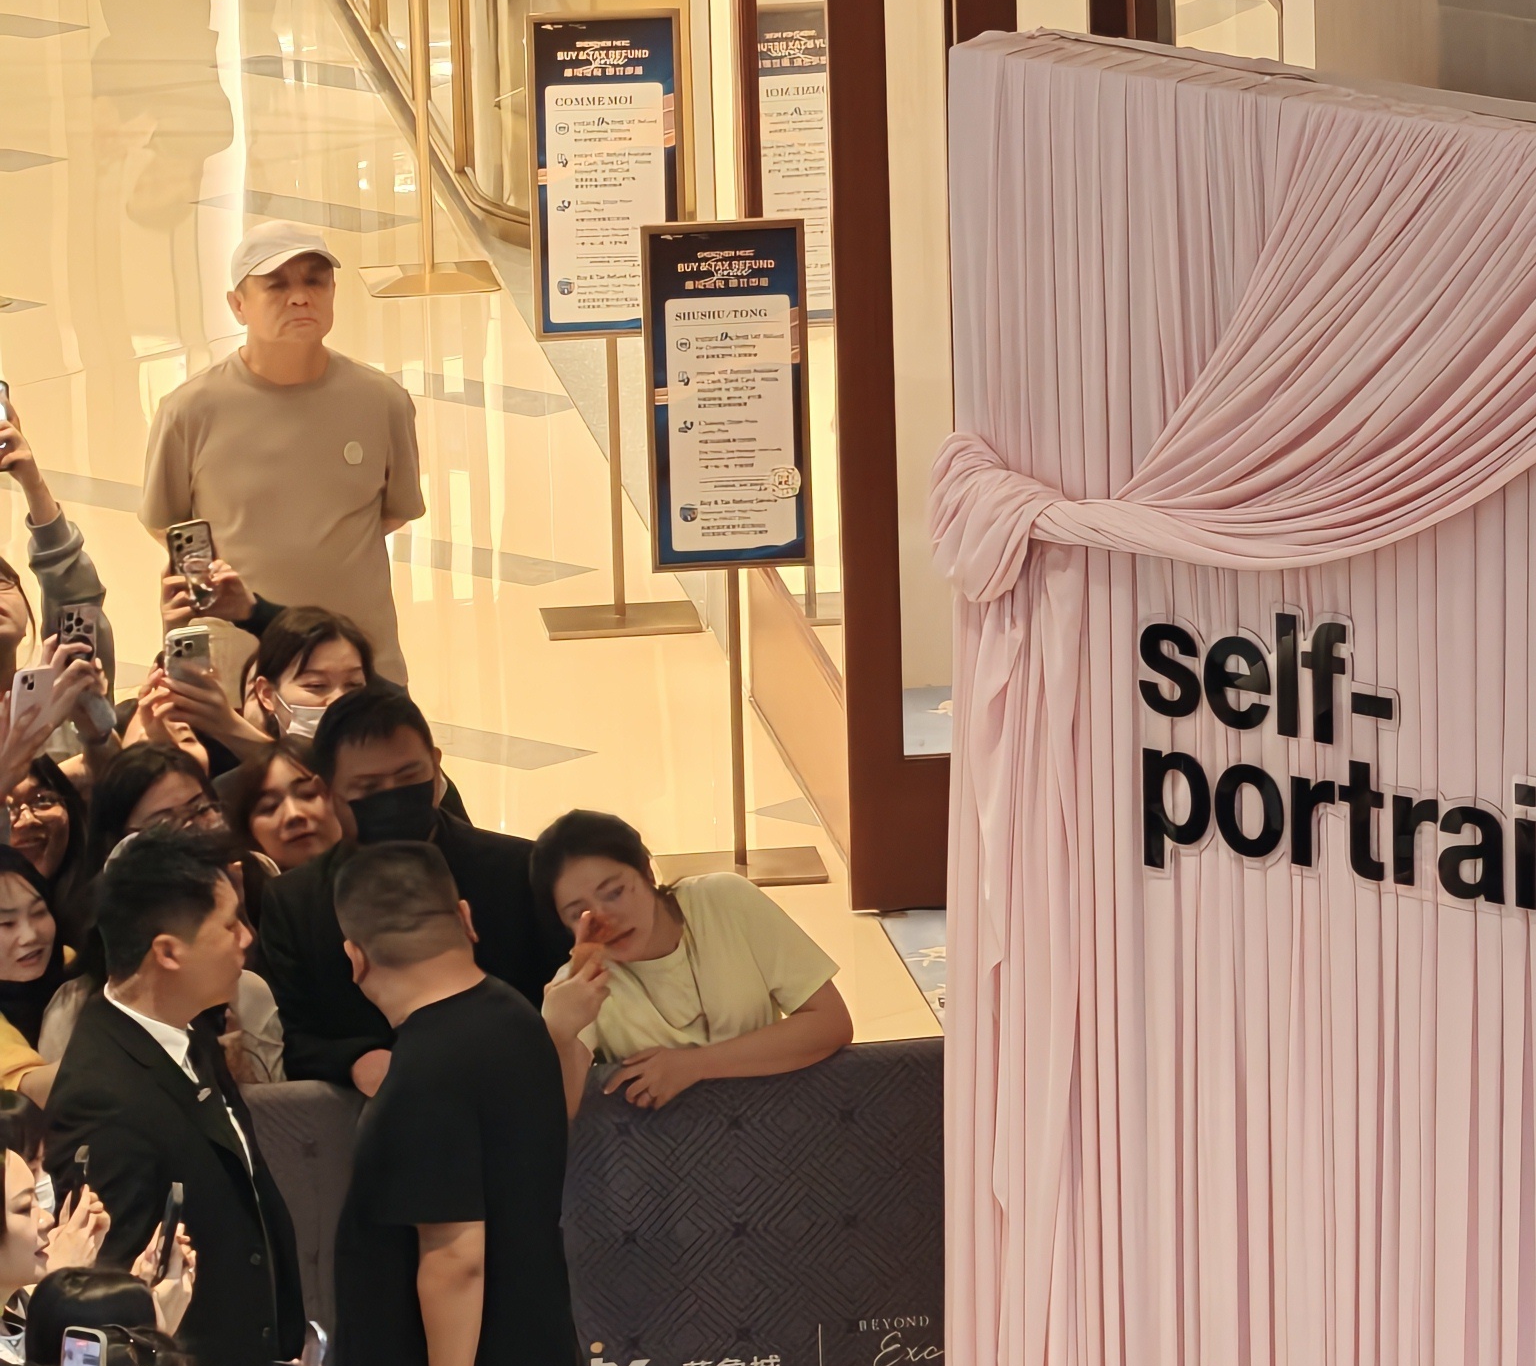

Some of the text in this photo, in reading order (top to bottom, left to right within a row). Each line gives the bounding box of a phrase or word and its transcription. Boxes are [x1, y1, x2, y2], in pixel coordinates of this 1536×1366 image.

[557, 50, 577, 61] BUY
[555, 95, 633, 106] COMME MOI
[677, 262, 699, 273] BUY
[675, 308, 768, 322] SHUSHU/TONG
[1138, 612, 1394, 745] self-
[858, 1316, 930, 1332] BEYOND
